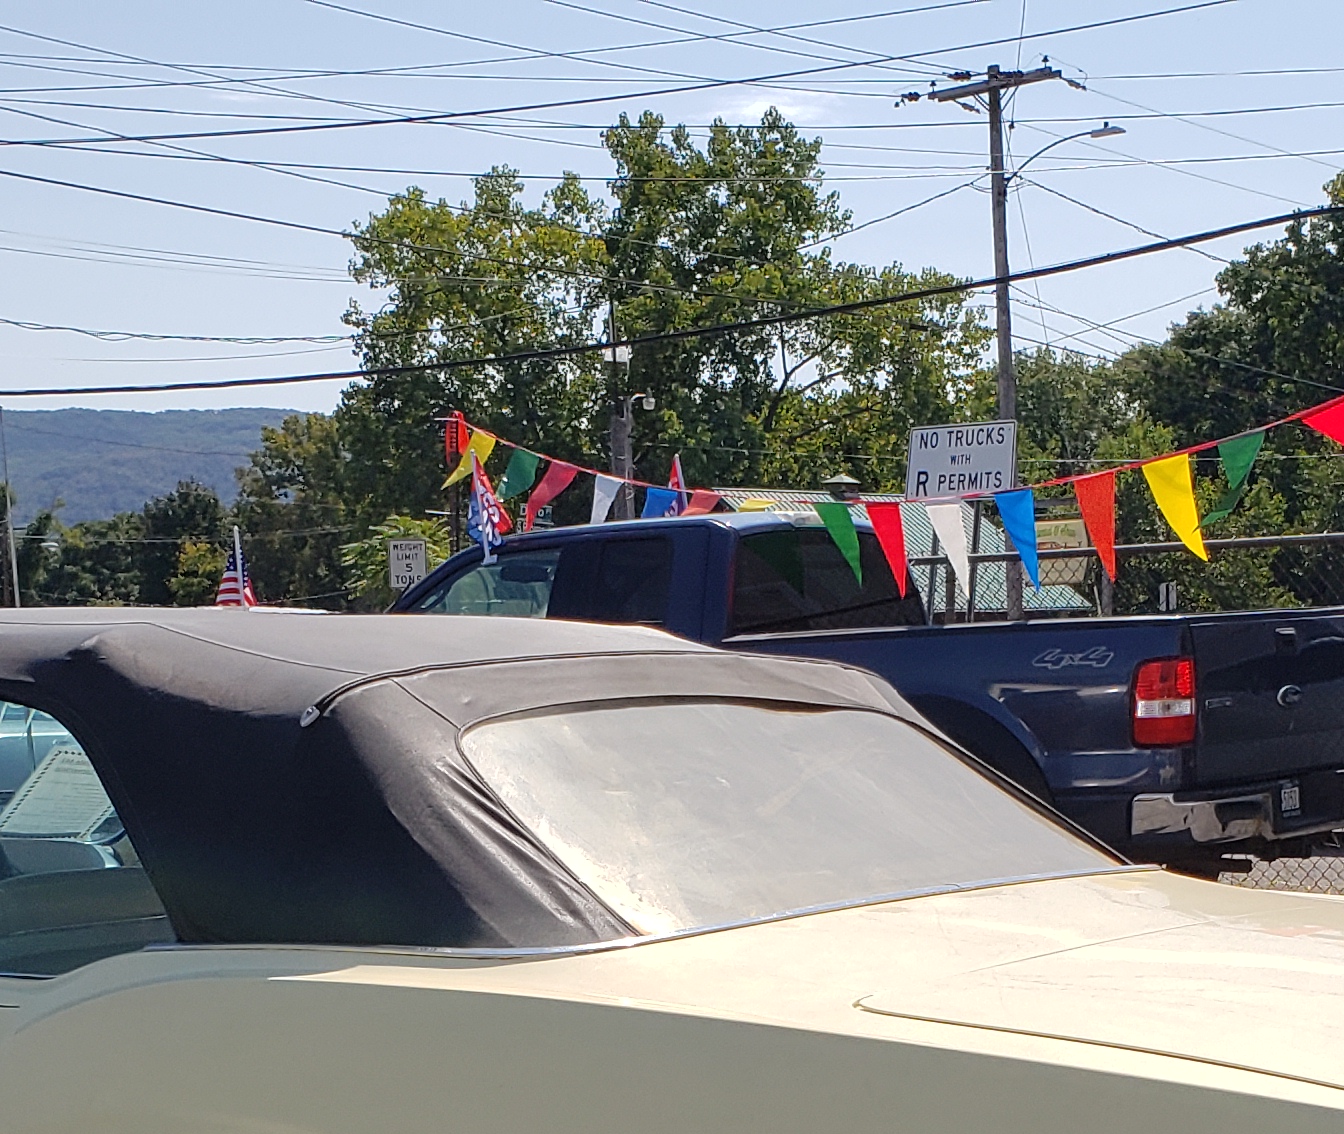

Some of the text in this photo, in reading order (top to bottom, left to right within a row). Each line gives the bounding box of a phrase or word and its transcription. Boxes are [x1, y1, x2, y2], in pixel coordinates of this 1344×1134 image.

[919, 426, 1005, 450] NO TRUCKS
[950, 454, 971, 465] WITH
[916, 471, 1002, 497] R PERMITS
[392, 543, 423, 551] WEIGHT
[397, 553, 419, 561] LIMIT
[405, 562, 413, 573] 5
[1032, 646, 1115, 670] 4x4
